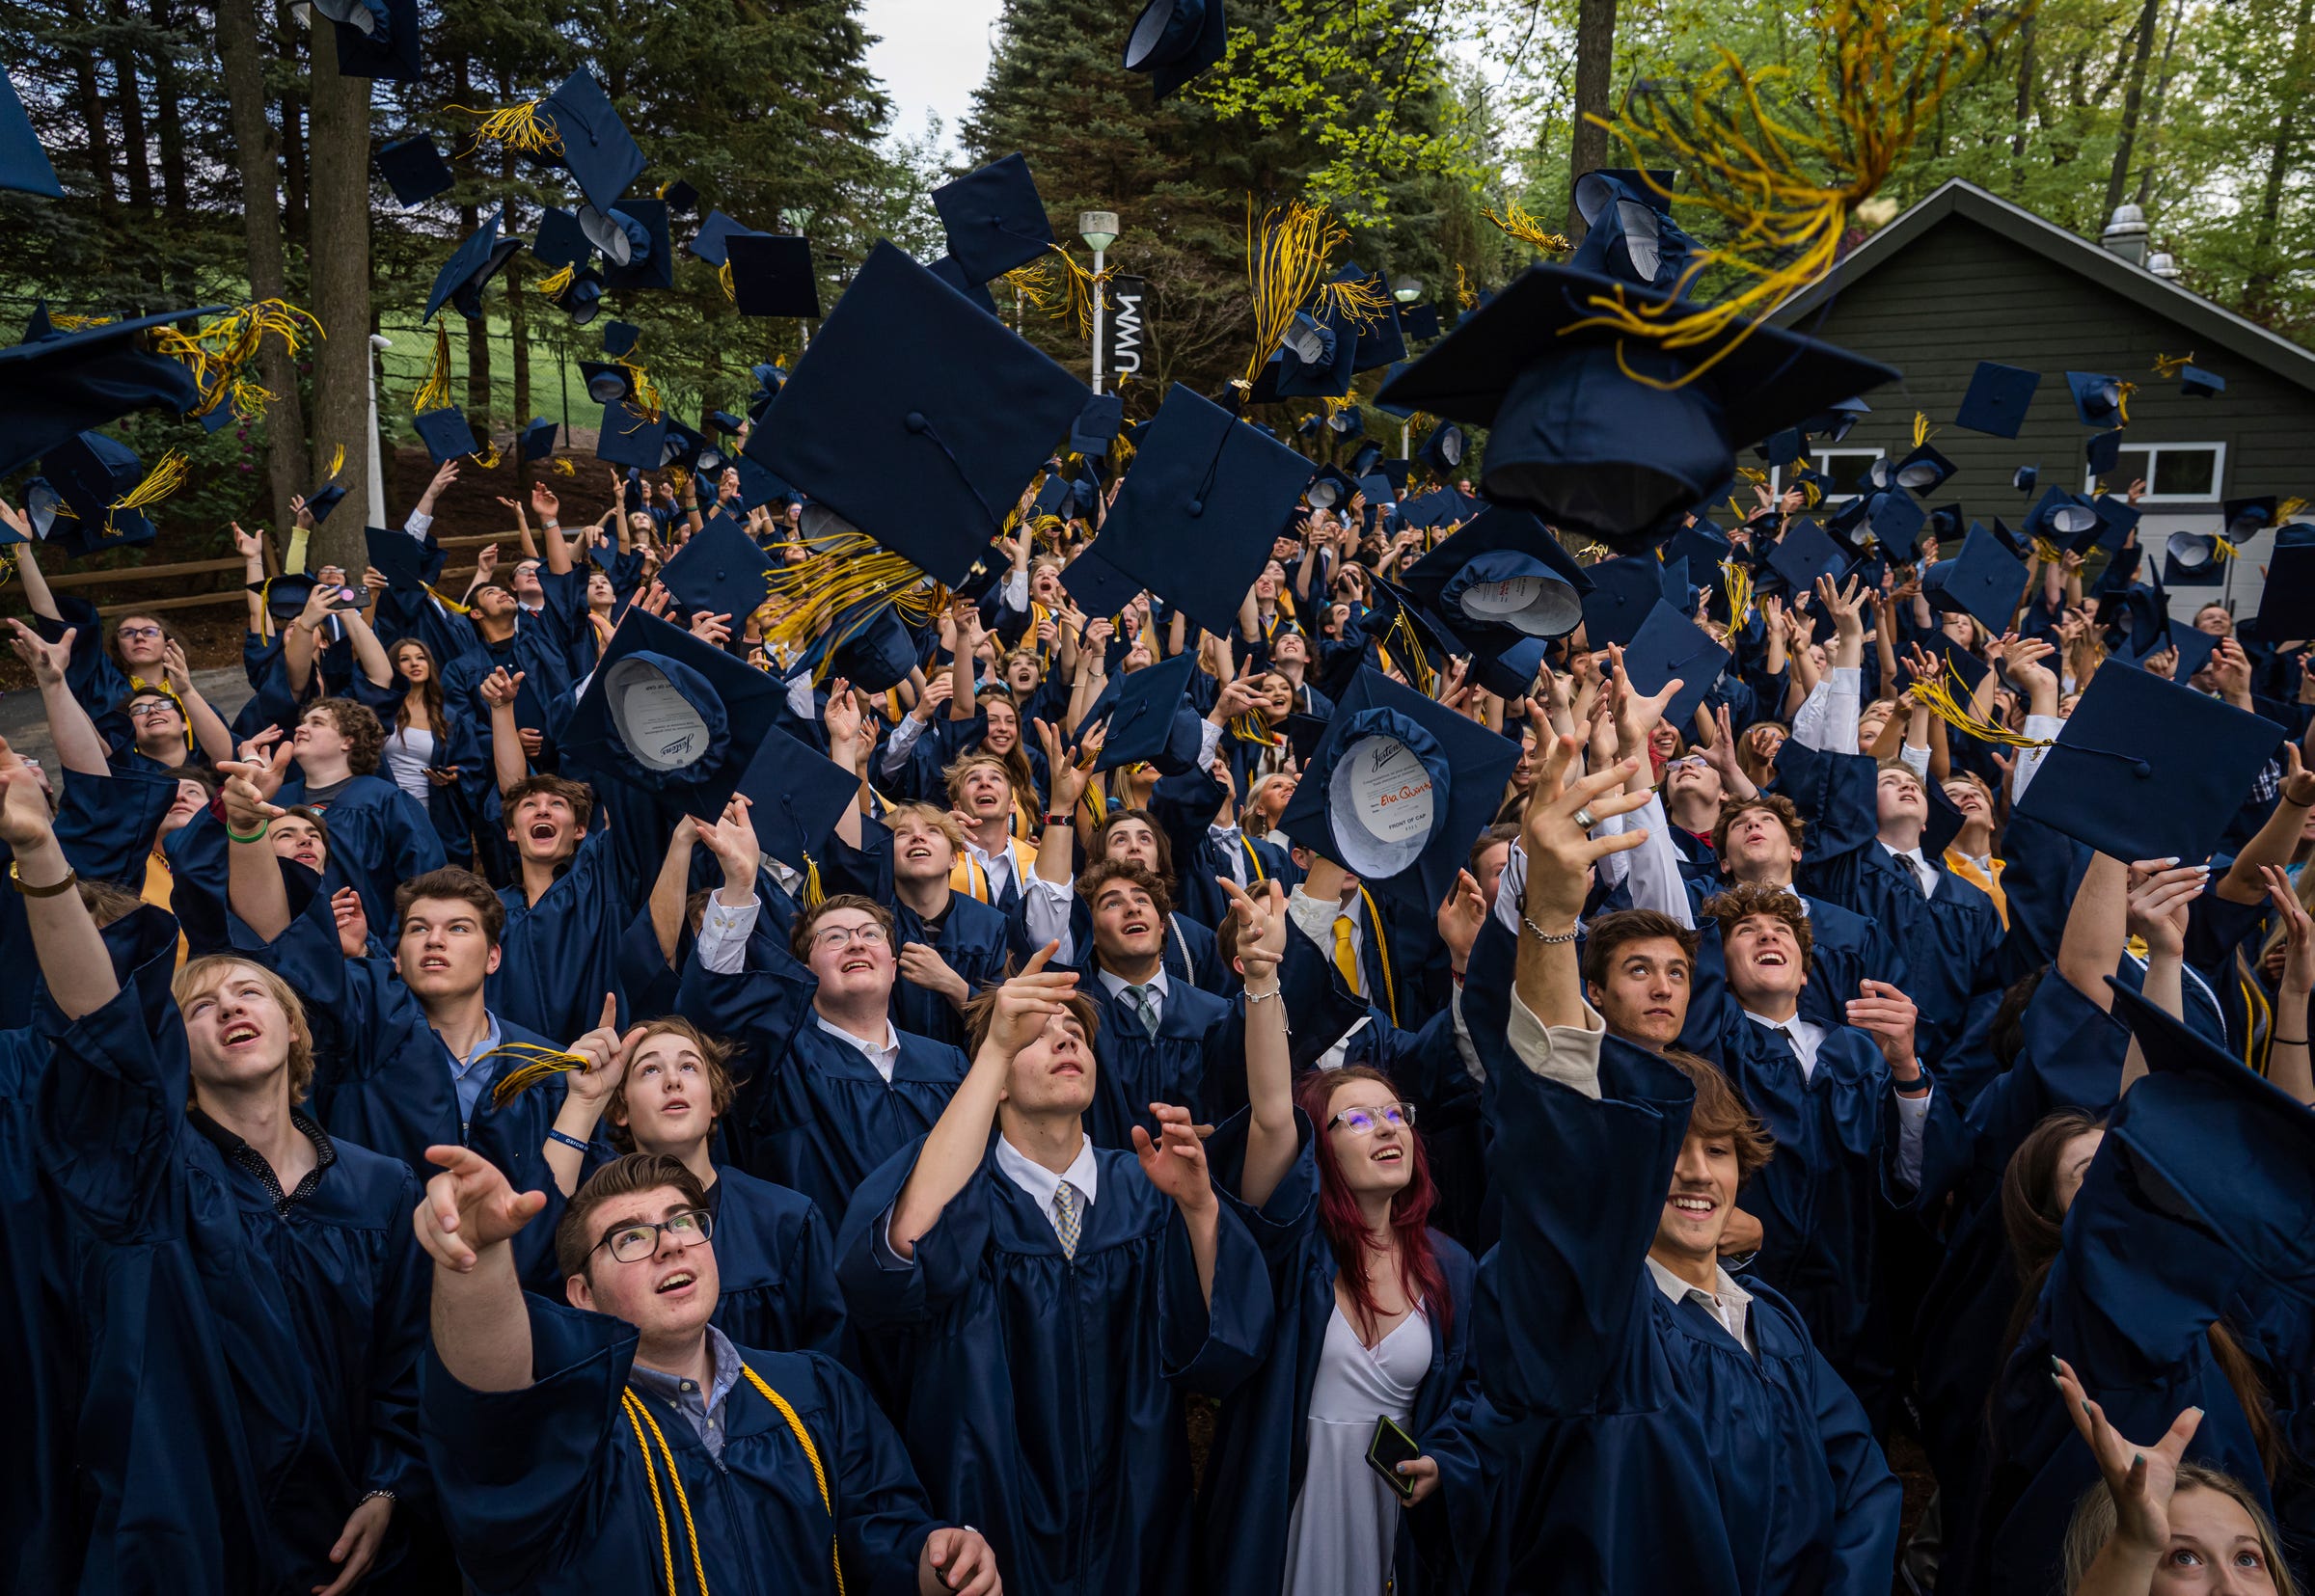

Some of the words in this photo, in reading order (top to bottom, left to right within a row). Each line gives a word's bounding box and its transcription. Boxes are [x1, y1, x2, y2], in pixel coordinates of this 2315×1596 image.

[1114, 296, 1142, 373] UWM
[660, 733, 694, 756] Jostens
[1372, 742, 1404, 773] Jostens
[1388, 820, 1406, 830] FRONT
